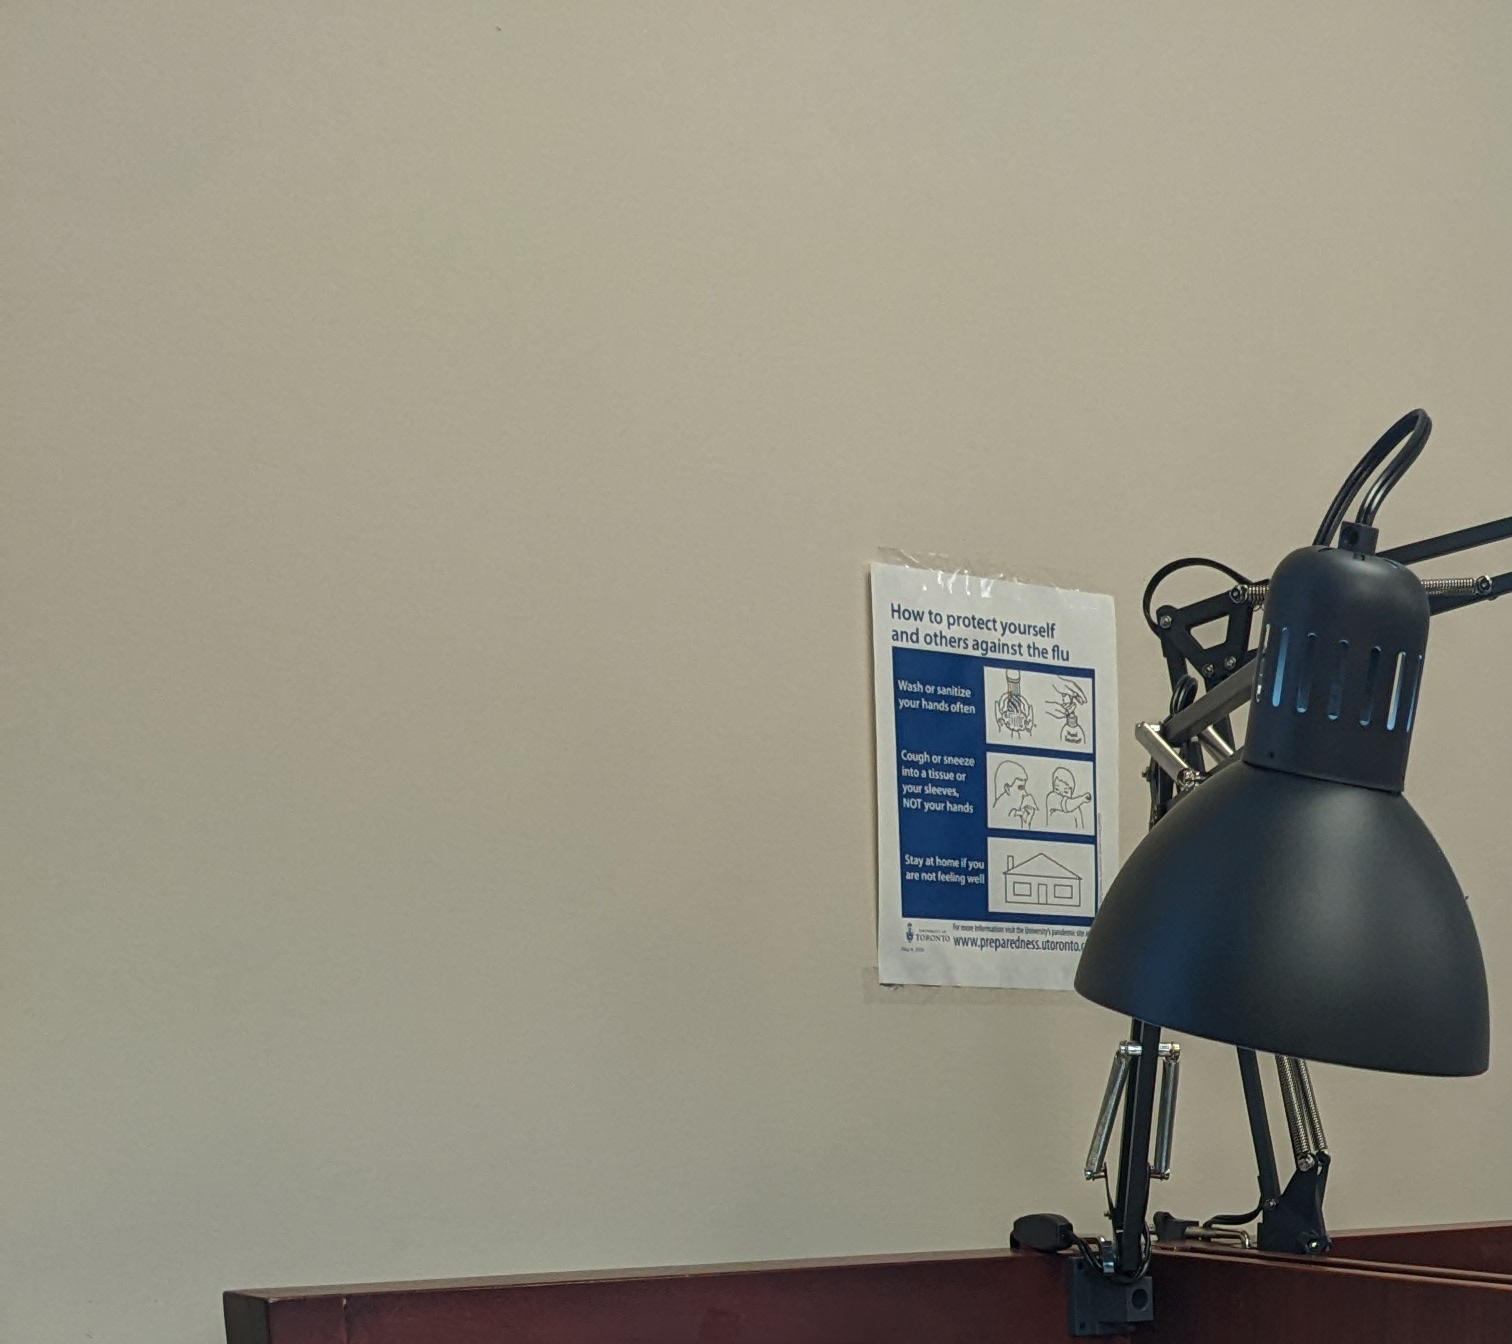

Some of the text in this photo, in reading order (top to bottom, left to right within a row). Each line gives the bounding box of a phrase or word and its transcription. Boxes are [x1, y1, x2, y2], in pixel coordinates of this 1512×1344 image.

[890, 602, 1055, 639] How to protect yourself
[891, 627, 1069, 661] and others against the flu
[897, 679, 971, 697] Wash or sanitize
[898, 697, 975, 713] your hands often
[900, 749, 974, 766] Cough or sneeze
[901, 766, 966, 781] into a tissue or
[901, 783, 959, 797] your sleeves,
[902, 797, 973, 813] NOT your hands
[904, 853, 984, 870] Stay at home if you
[905, 870, 984, 885] are not feeling well
[915, 933, 950, 942] TORONTO
